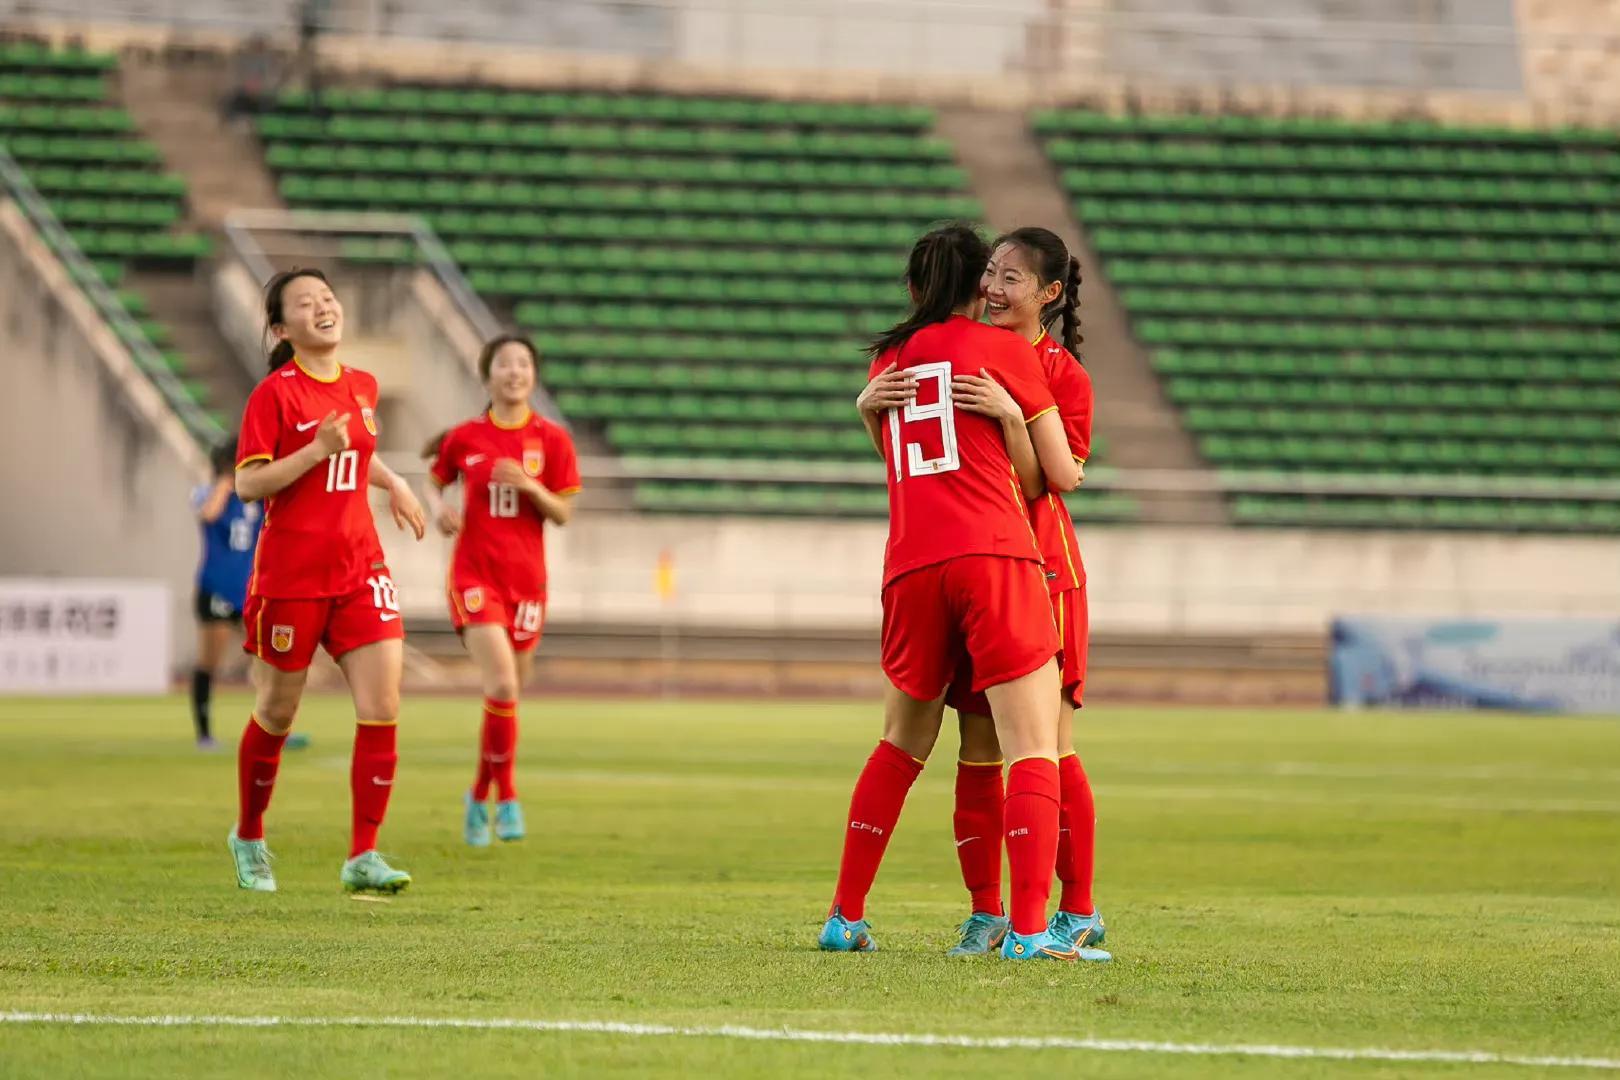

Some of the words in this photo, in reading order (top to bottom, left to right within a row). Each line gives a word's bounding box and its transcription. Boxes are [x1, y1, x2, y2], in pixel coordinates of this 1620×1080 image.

[887, 360, 961, 484] 19
[326, 449, 358, 493] 10
[488, 482, 519, 518] 18
[366, 575, 400, 612] 10
[850, 821, 883, 836] CFA
